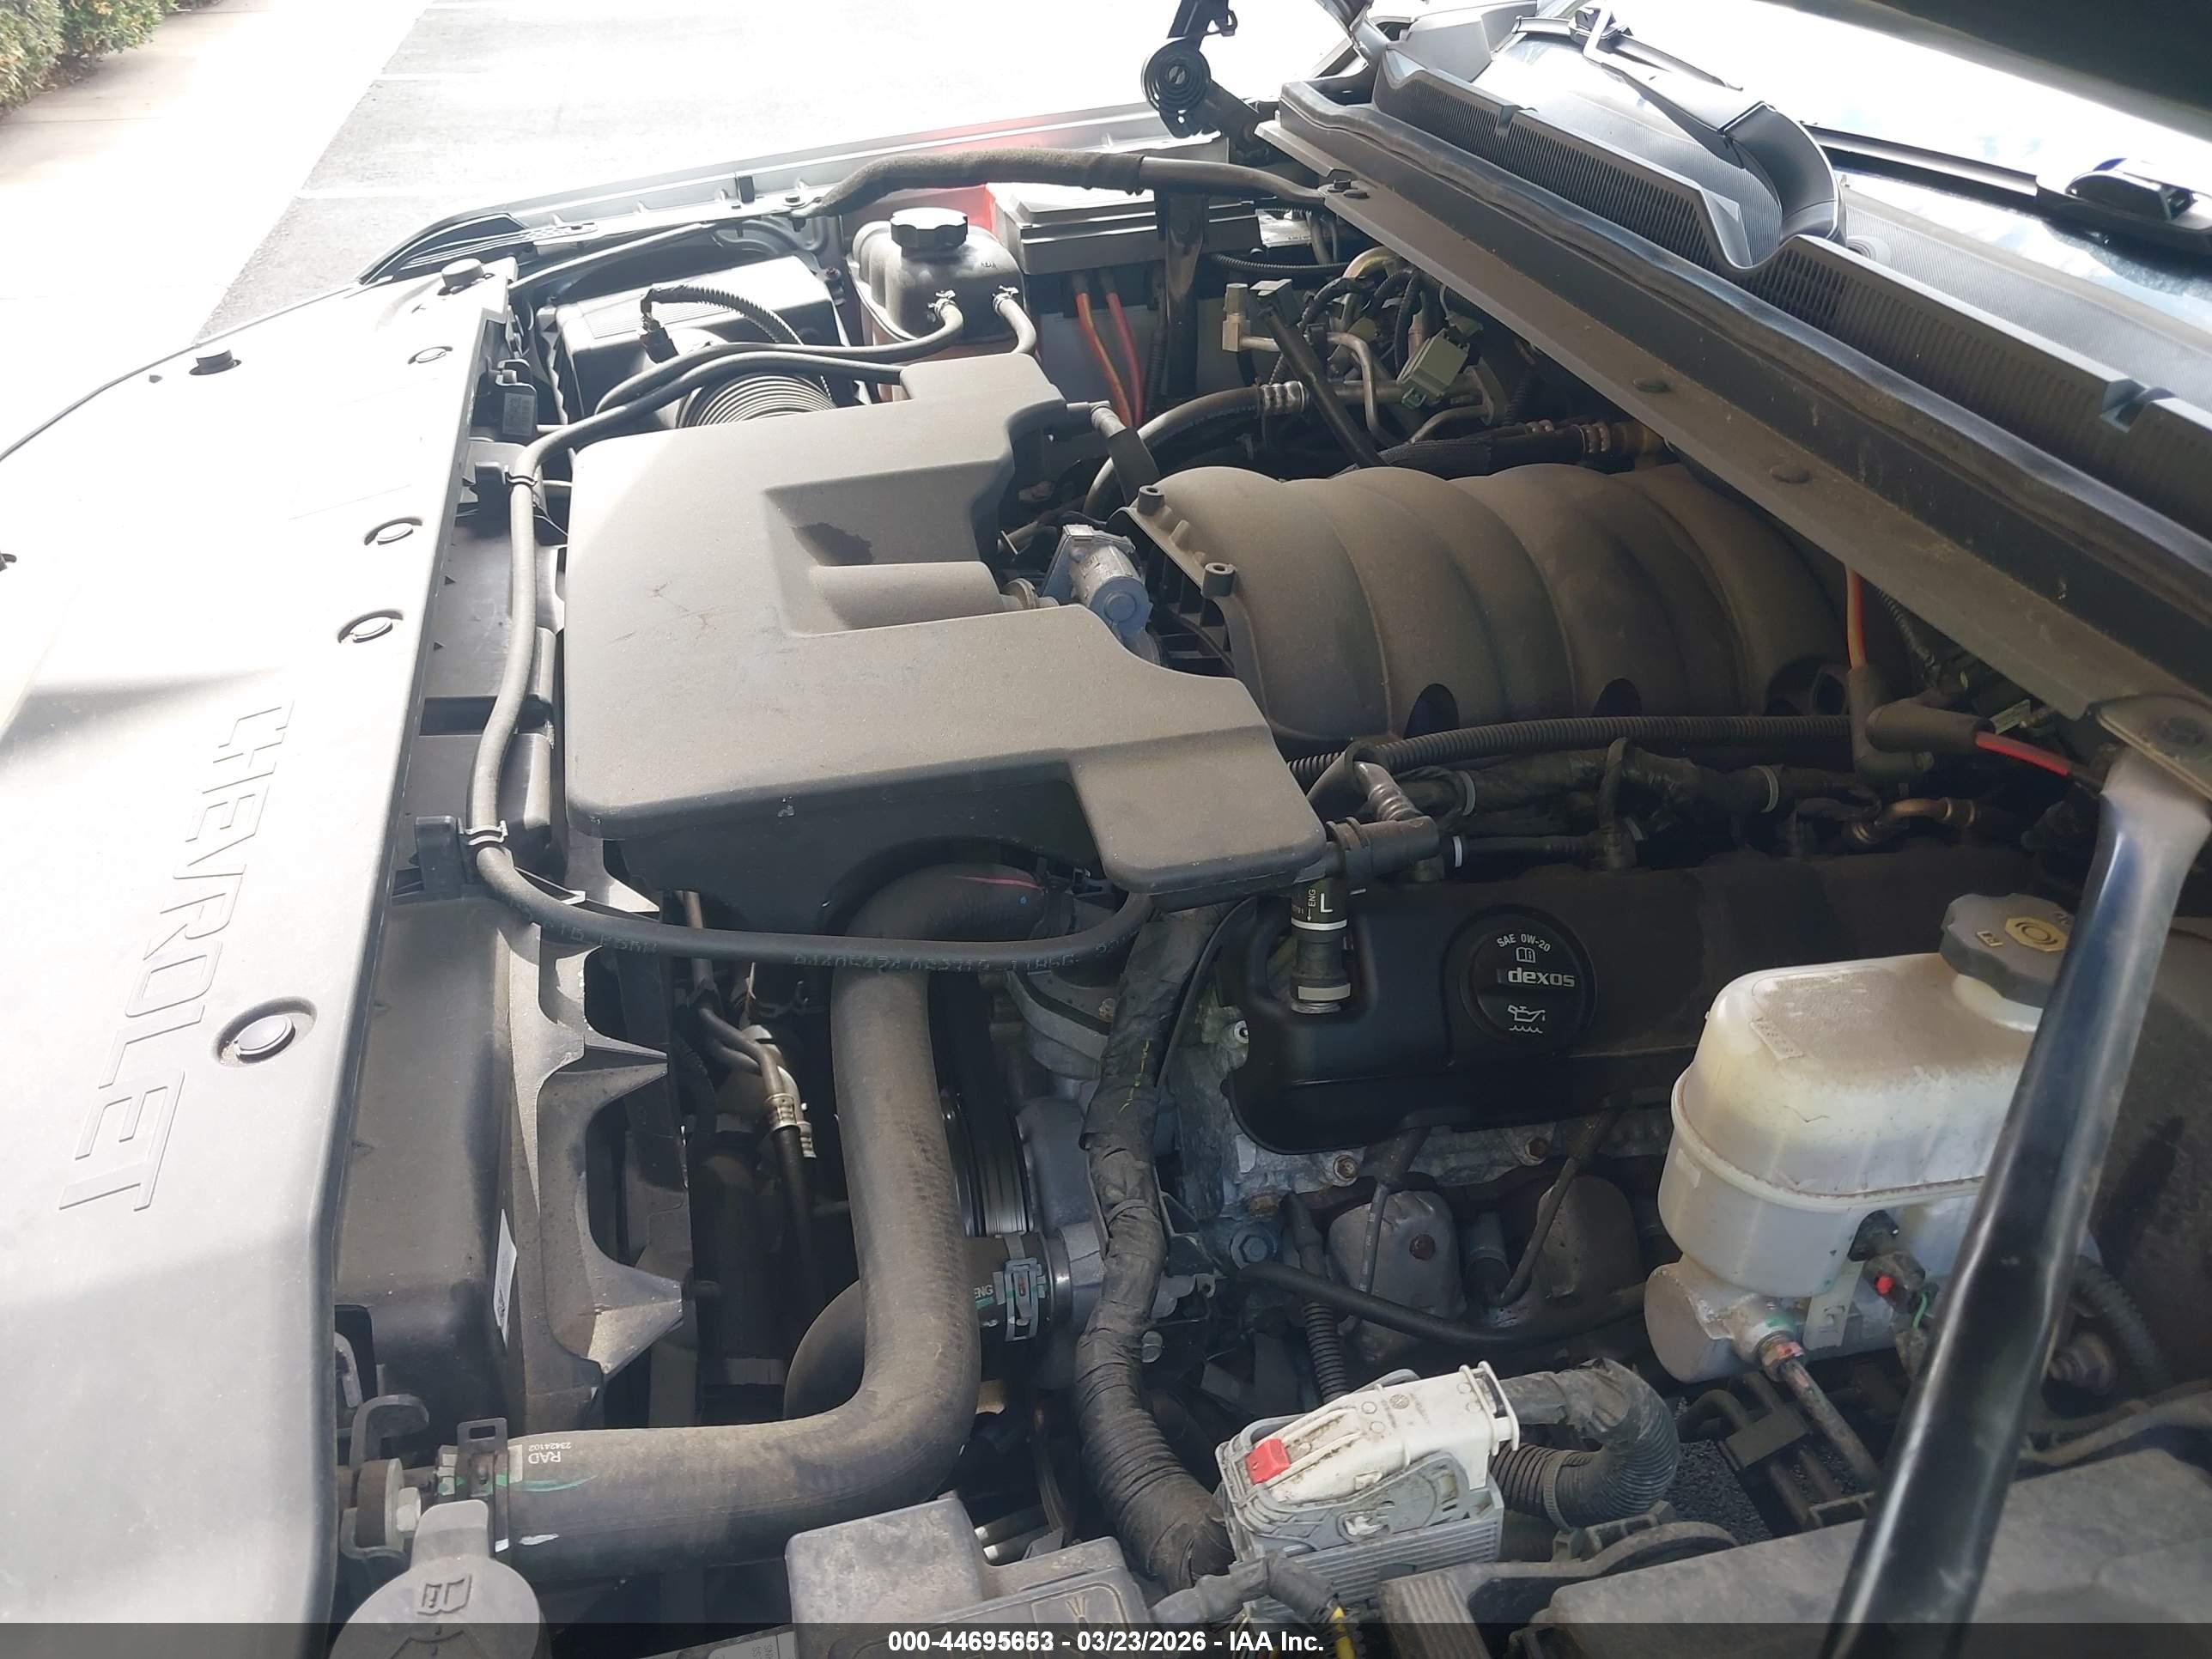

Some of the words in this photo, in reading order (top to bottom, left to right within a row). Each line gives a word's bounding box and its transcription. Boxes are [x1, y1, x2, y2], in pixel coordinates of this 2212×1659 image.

[1308, 889, 1316, 908] ENG
[1320, 892, 1334, 913] L
[1497, 933, 1517, 948] SAE
[1520, 933, 1552, 952] 0W-20
[58, 700, 295, 1212] CHEVROLET
[1507, 967, 1576, 988] dexos
[527, 1450, 562, 1464] RAD
